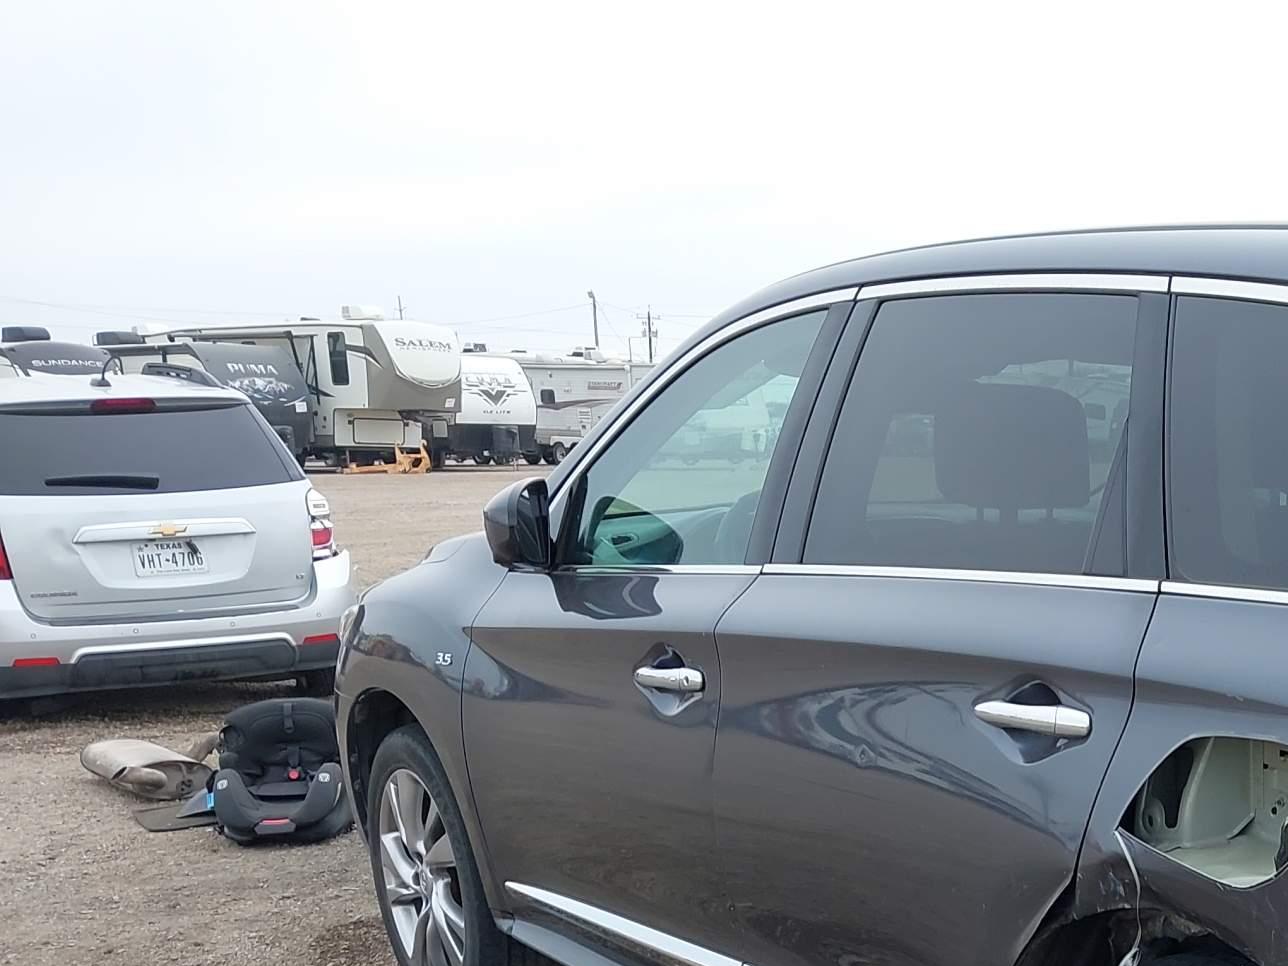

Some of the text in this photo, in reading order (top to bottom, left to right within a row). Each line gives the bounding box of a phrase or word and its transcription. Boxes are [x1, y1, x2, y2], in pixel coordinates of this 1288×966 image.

[394, 337, 452, 350] SALEM
[31, 359, 105, 368] SUNDANCE
[226, 363, 279, 376] PUMA
[154, 542, 184, 551] TEXAS
